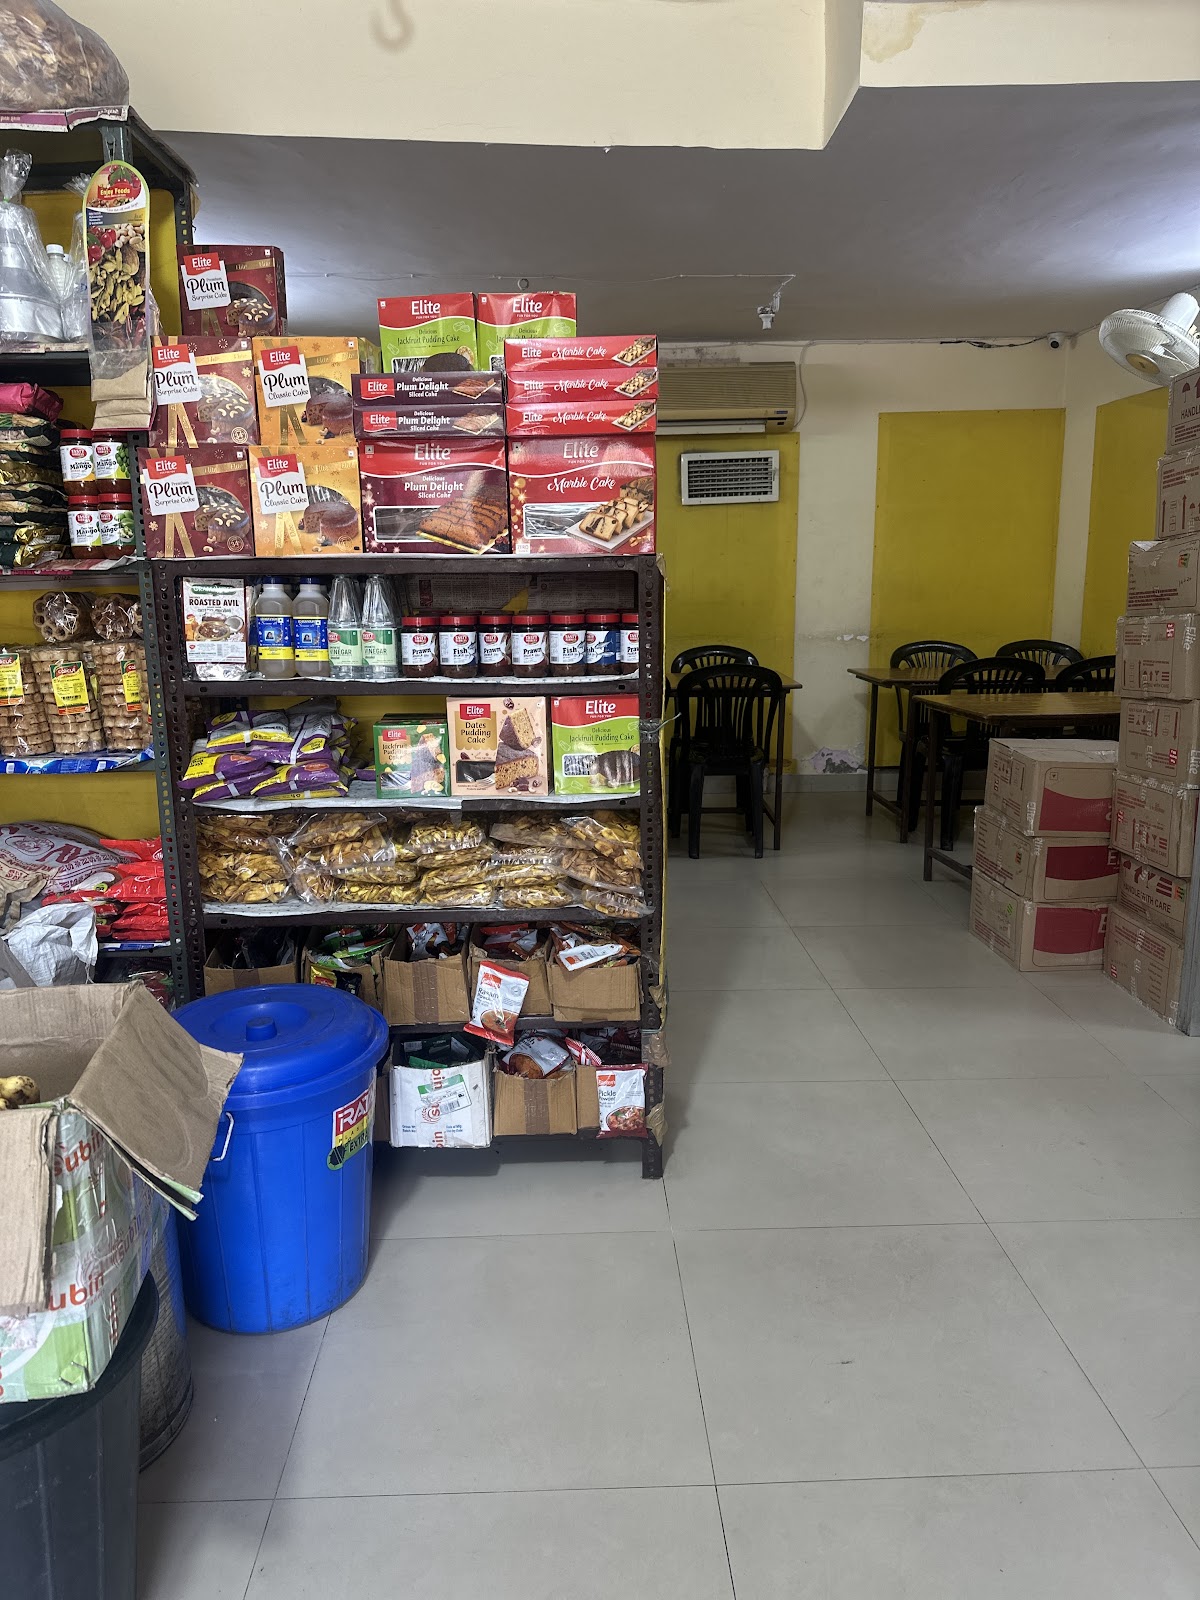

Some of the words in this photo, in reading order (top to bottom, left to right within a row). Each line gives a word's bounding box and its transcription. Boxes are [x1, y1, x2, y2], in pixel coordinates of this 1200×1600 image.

[192, 257, 211, 268] Elite
[187, 278, 226, 294] Plum
[411, 300, 440, 315] Elite
[513, 298, 542, 313] Elite
[398, 336, 421, 345] Jackfruit
[423, 335, 446, 344] Pudding
[158, 349, 179, 360] Elite
[270, 351, 291, 362] Elite
[521, 348, 542, 358] Elite
[552, 347, 584, 359] Marble
[586, 346, 607, 357] Cake
[155, 371, 196, 388] Plum
[264, 373, 307, 392] Plum
[524, 380, 544, 390] Elite
[368, 382, 388, 392] Elite
[397, 383, 417, 391] Plum
[419, 382, 449, 393] Delight
[554, 380, 587, 393] Marble
[588, 379, 609, 390] Cake
[268, 392, 291, 400] Classic
[370, 415, 390, 424] Elite
[398, 417, 419, 425] Plum
[420, 416, 451, 426] Delight
[523, 412, 543, 423] Elite
[553, 412, 586, 425] Marble
[587, 411, 607, 422] Cake
[414, 443, 451, 460] Elite
[563, 442, 599, 458] Elite
[155, 460, 177, 472] Elite
[267, 459, 288, 470] Elite
[260, 481, 305, 499] Plum
[404, 482, 428, 492] Plum
[430, 482, 463, 493] Delight
[547, 477, 588, 493] Marble
[590, 476, 616, 490] Cake
[149, 482, 193, 499] Plum
[264, 499, 289, 507] Classic
[189, 598, 221, 606] ROASTED
[466, 706, 484, 715] Elite
[585, 699, 616, 714] Elite
[460, 729, 491, 738] Pudding
[570, 735, 594, 743] Jackfruit
[595, 734, 619, 742] Pudding
[1189, 750, 1199, 774] Elite
[1123, 883, 1140, 898] HANDLE
[1155, 899, 1171, 913] CARE
[49, 1271, 104, 1311] ubin
